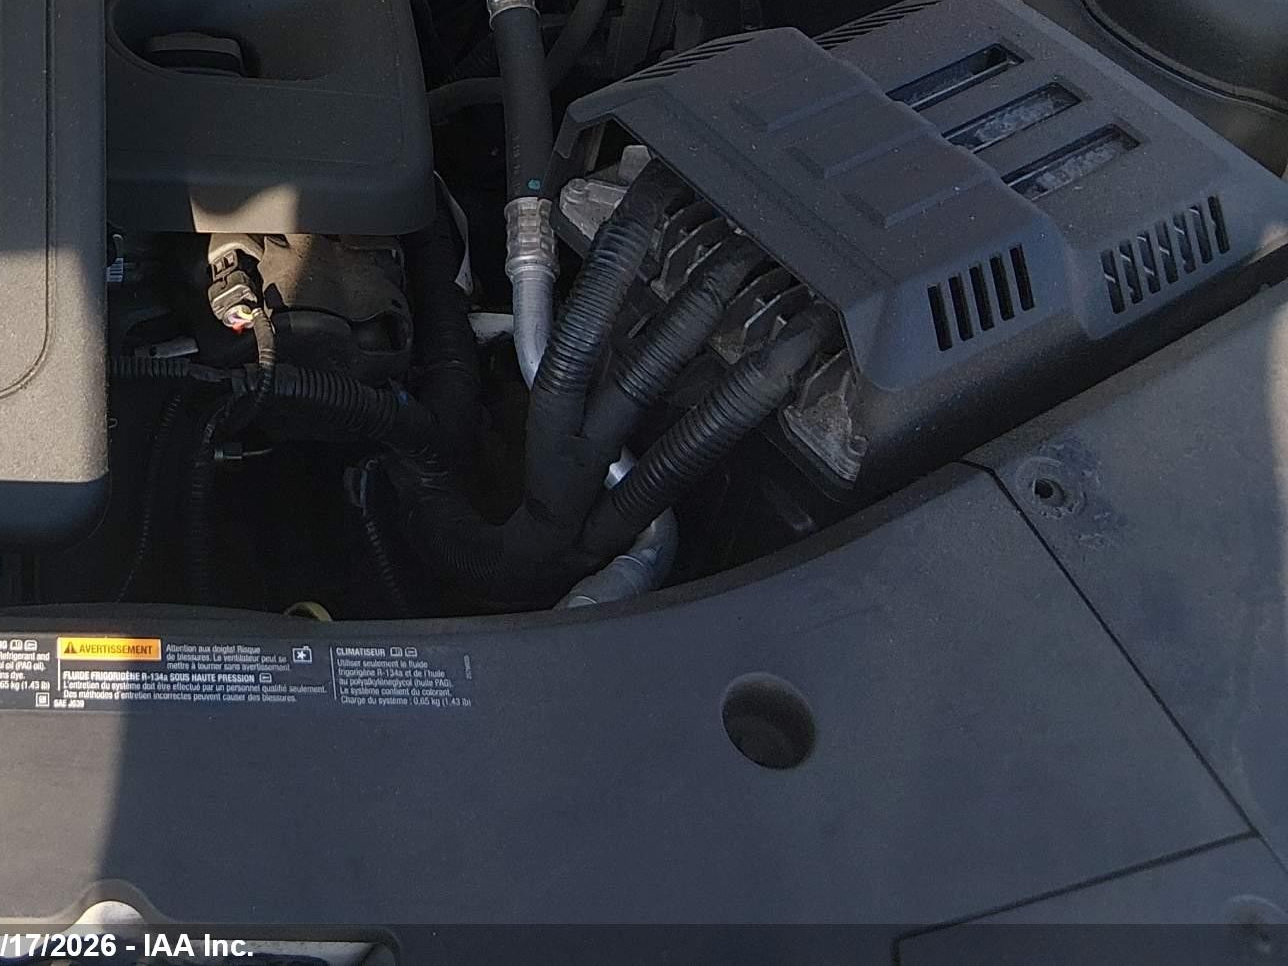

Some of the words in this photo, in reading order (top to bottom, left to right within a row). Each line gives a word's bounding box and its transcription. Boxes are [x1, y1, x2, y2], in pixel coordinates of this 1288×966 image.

[79, 644, 152, 654] AVERTISSEMENT
[166, 644, 197, 653] Attention
[198, 645, 211, 653] aux
[237, 645, 261, 654] Risque
[336, 647, 386, 657] CLIMATISEUR
[36, 652, 50, 661] and
[166, 653, 175, 661] de
[213, 654, 222, 662] Le
[223, 655, 259, 663] ventilateur
[261, 655, 277, 663] peut
[5, 661, 14, 670] oil
[15, 661, 32, 671] (PAG
[166, 662, 190, 670] mettre
[197, 662, 223, 670] tourner
[223, 663, 240, 671] sans
[337, 658, 361, 667] Utiliser
[362, 659, 399, 668] seulement
[400, 660, 407, 668] le
[408, 660, 428, 669] fluide
[10, 672, 25, 681] dye.
[62, 671, 89, 681] FLUIDE
[141, 672, 168, 681] R-134a
[170, 673, 190, 682] SOUS
[192, 673, 216, 682] HAUTE
[217, 674, 255, 683] PRESSION
[338, 667, 376, 678] frigorigène
[377, 668, 403, 677] R-134a
[404, 669, 412, 677] et
[413, 669, 422, 677] de
[423, 669, 445, 678] l'huile
[10, 681, 20, 691] kg
[21, 681, 40, 690] (1.43
[40, 681, 51, 691] lb)
[63, 681, 100, 690] L'entretien
[101, 681, 109, 690] du
[111, 681, 140, 691] système
[142, 682, 155, 690] doit
[157, 682, 171, 691] être
[172, 683, 201, 691] effectué
[202, 684, 214, 692] par
[226, 684, 260, 693] personnel
[413, 678, 433, 688] (huile
[340, 685, 349, 695] Le
[350, 686, 380, 696] système
[381, 687, 409, 696] contient
[410, 688, 420, 696] du
[63, 690, 75, 699] Des
[78, 690, 113, 699] méthodes
[114, 691, 152, 700] d'entretien
[152, 692, 191, 700] incorrectes
[193, 693, 221, 702] peuvent
[341, 695, 366, 706] Charge
[368, 695, 377, 705] du
[378, 696, 408, 706] système
[431, 697, 441, 707] kg
[53, 699, 67, 708] SAE
